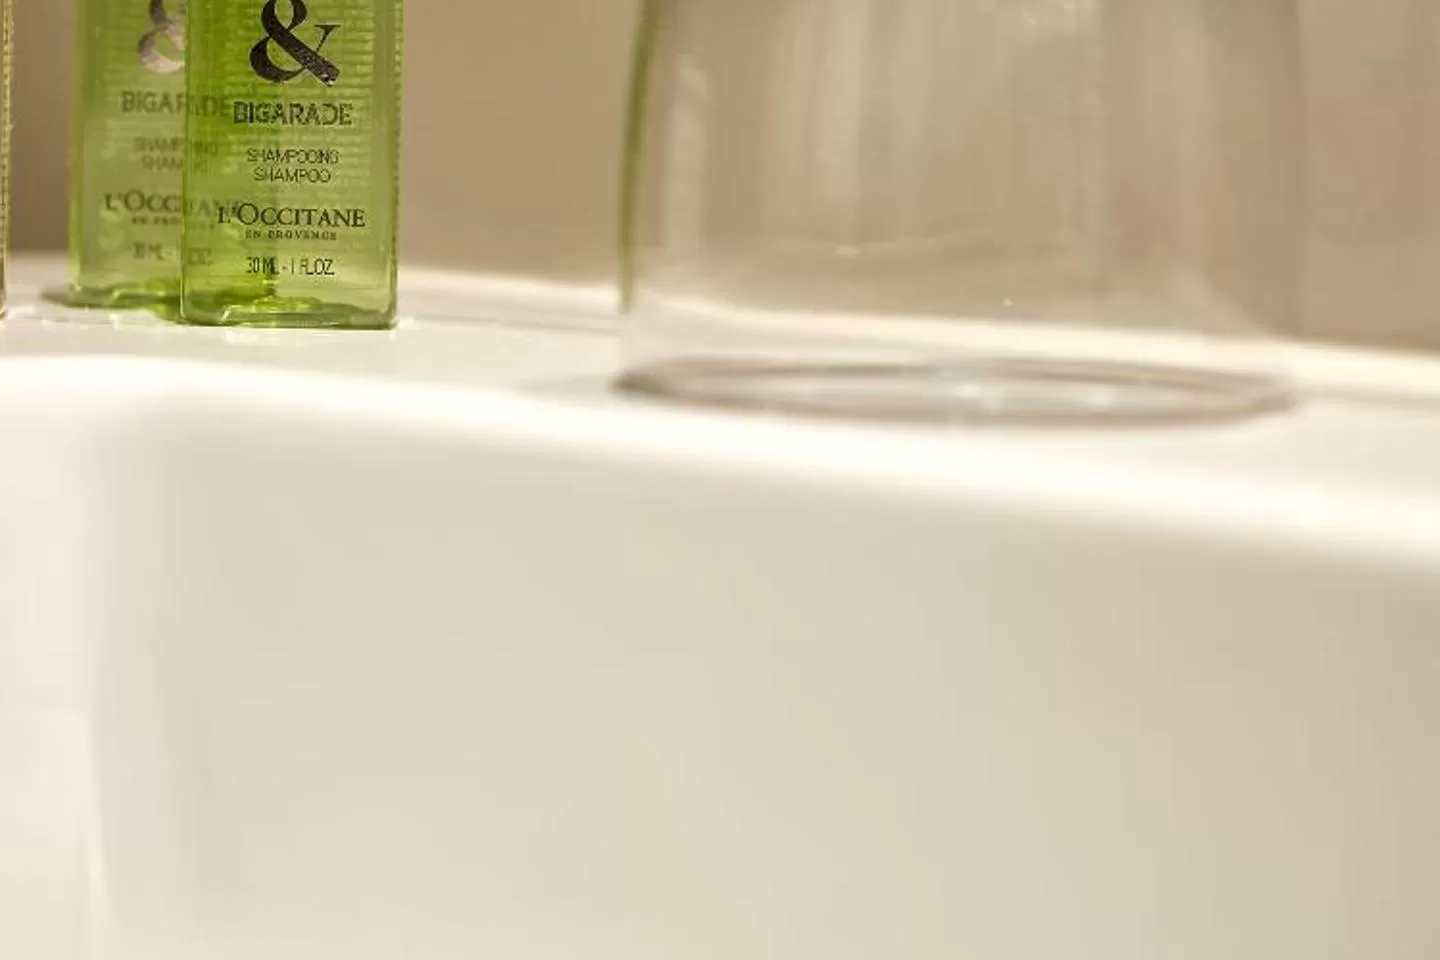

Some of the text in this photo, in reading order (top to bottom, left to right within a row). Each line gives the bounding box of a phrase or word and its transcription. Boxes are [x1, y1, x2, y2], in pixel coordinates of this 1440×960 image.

[233, 101, 353, 126] BIGARADE
[253, 168, 331, 183] SHAMPOO
[218, 203, 366, 227] L'OCCITANE
